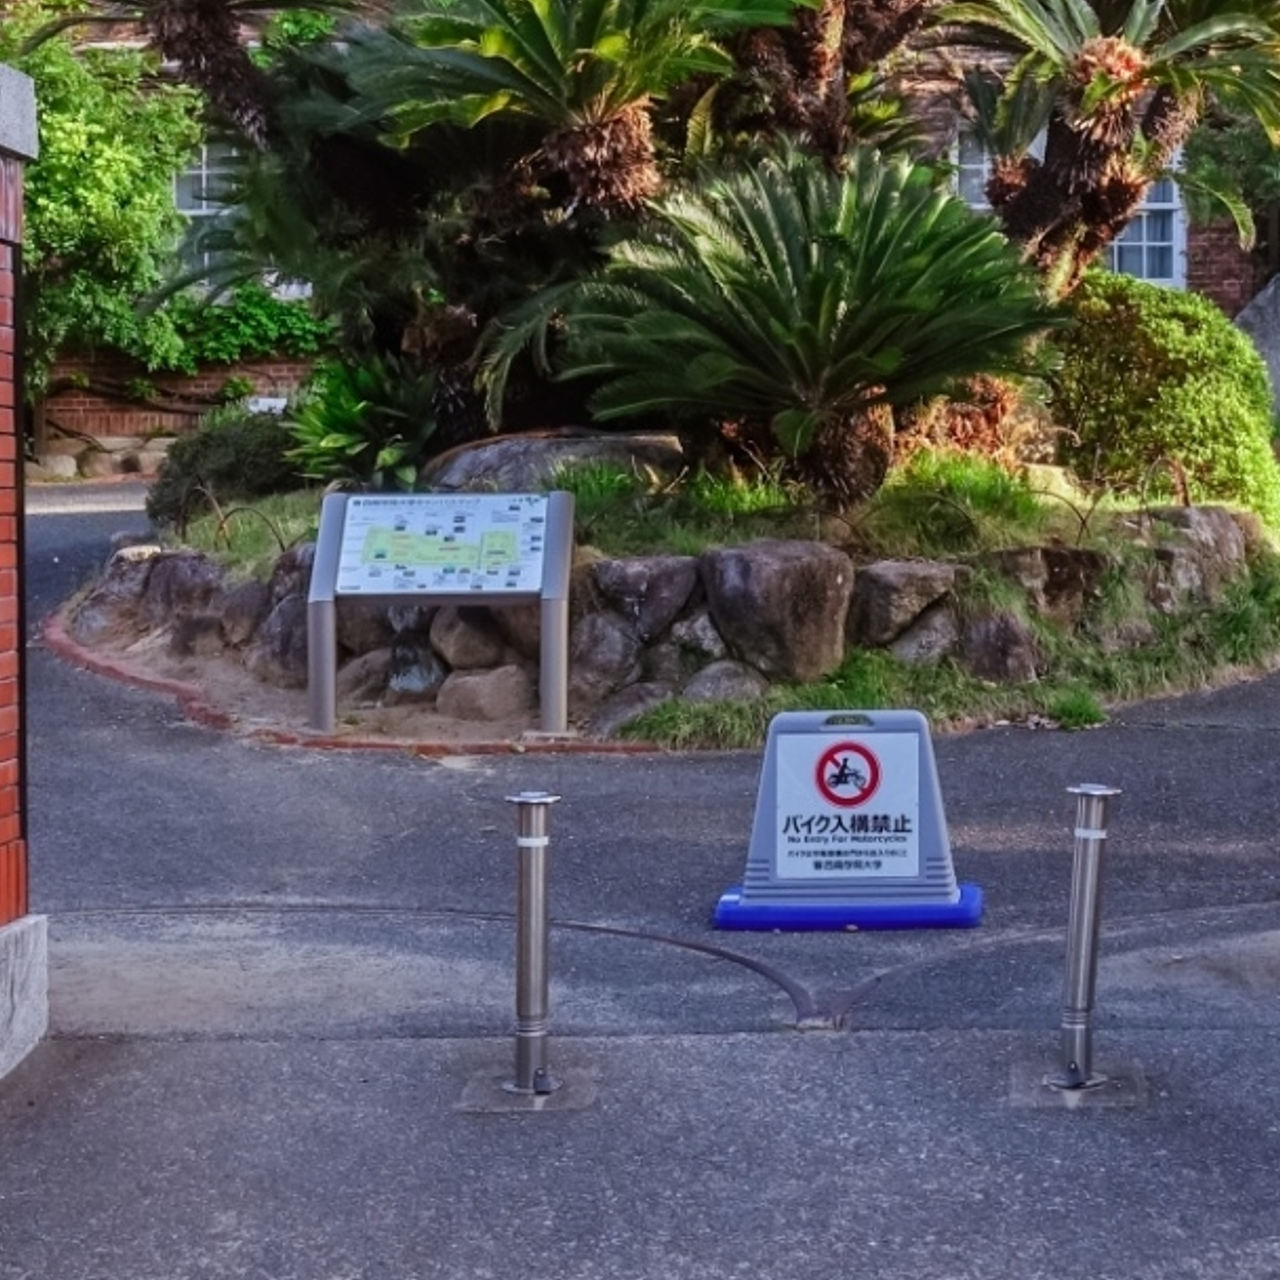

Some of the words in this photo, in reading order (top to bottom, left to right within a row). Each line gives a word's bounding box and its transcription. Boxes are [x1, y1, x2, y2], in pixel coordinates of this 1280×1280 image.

[782, 814, 913, 834] バイク入構禁止
[787, 836, 801, 844] No
[804, 836, 829, 845] Entry
[832, 835, 848, 844] For
[851, 835, 907, 845] Motorcycles
